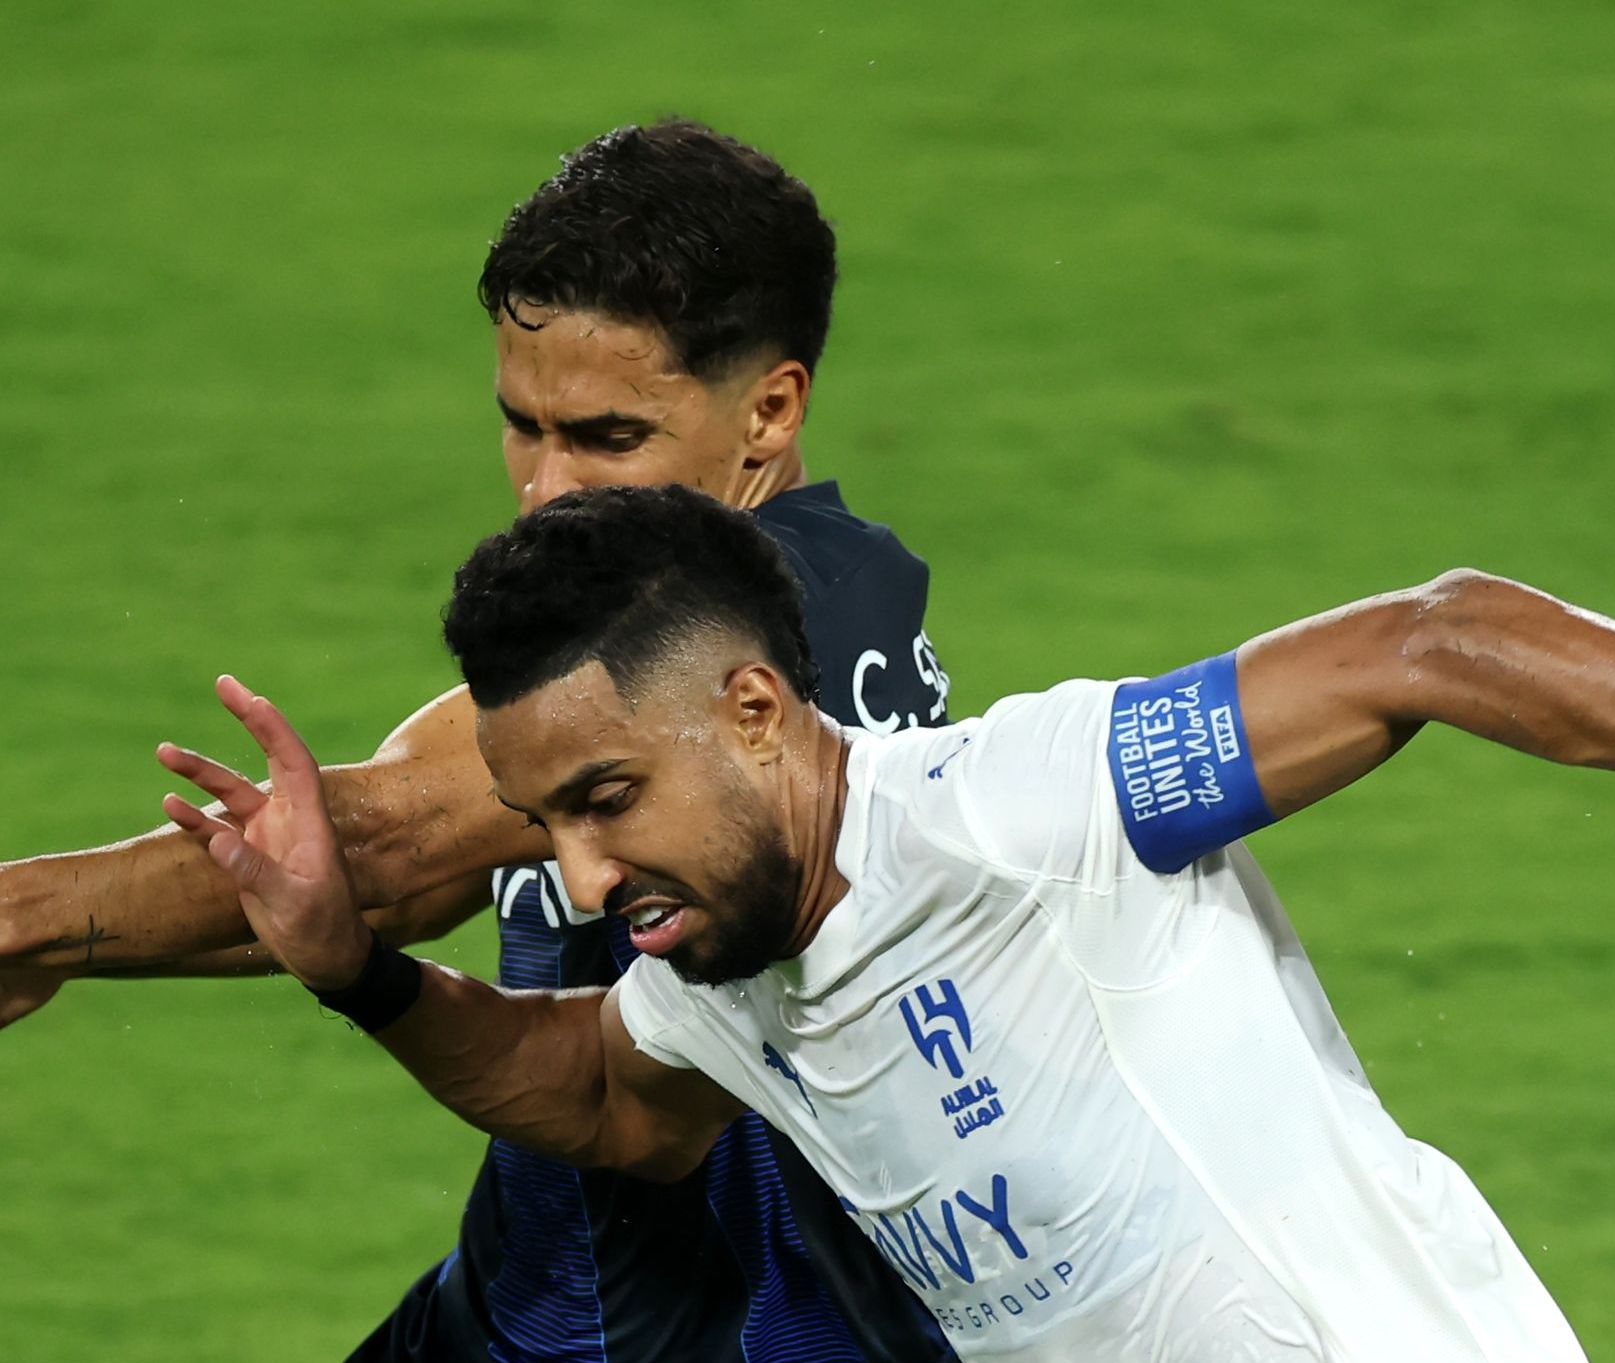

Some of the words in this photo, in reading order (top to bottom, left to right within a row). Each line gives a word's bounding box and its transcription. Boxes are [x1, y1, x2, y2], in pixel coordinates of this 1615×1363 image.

[1114, 702, 1158, 822] FOOTBALL
[1140, 696, 1191, 815] UNITES
[1174, 681, 1211, 762] World
[1192, 762, 1224, 809] the
[965, 1261, 1074, 1328] GROUP
